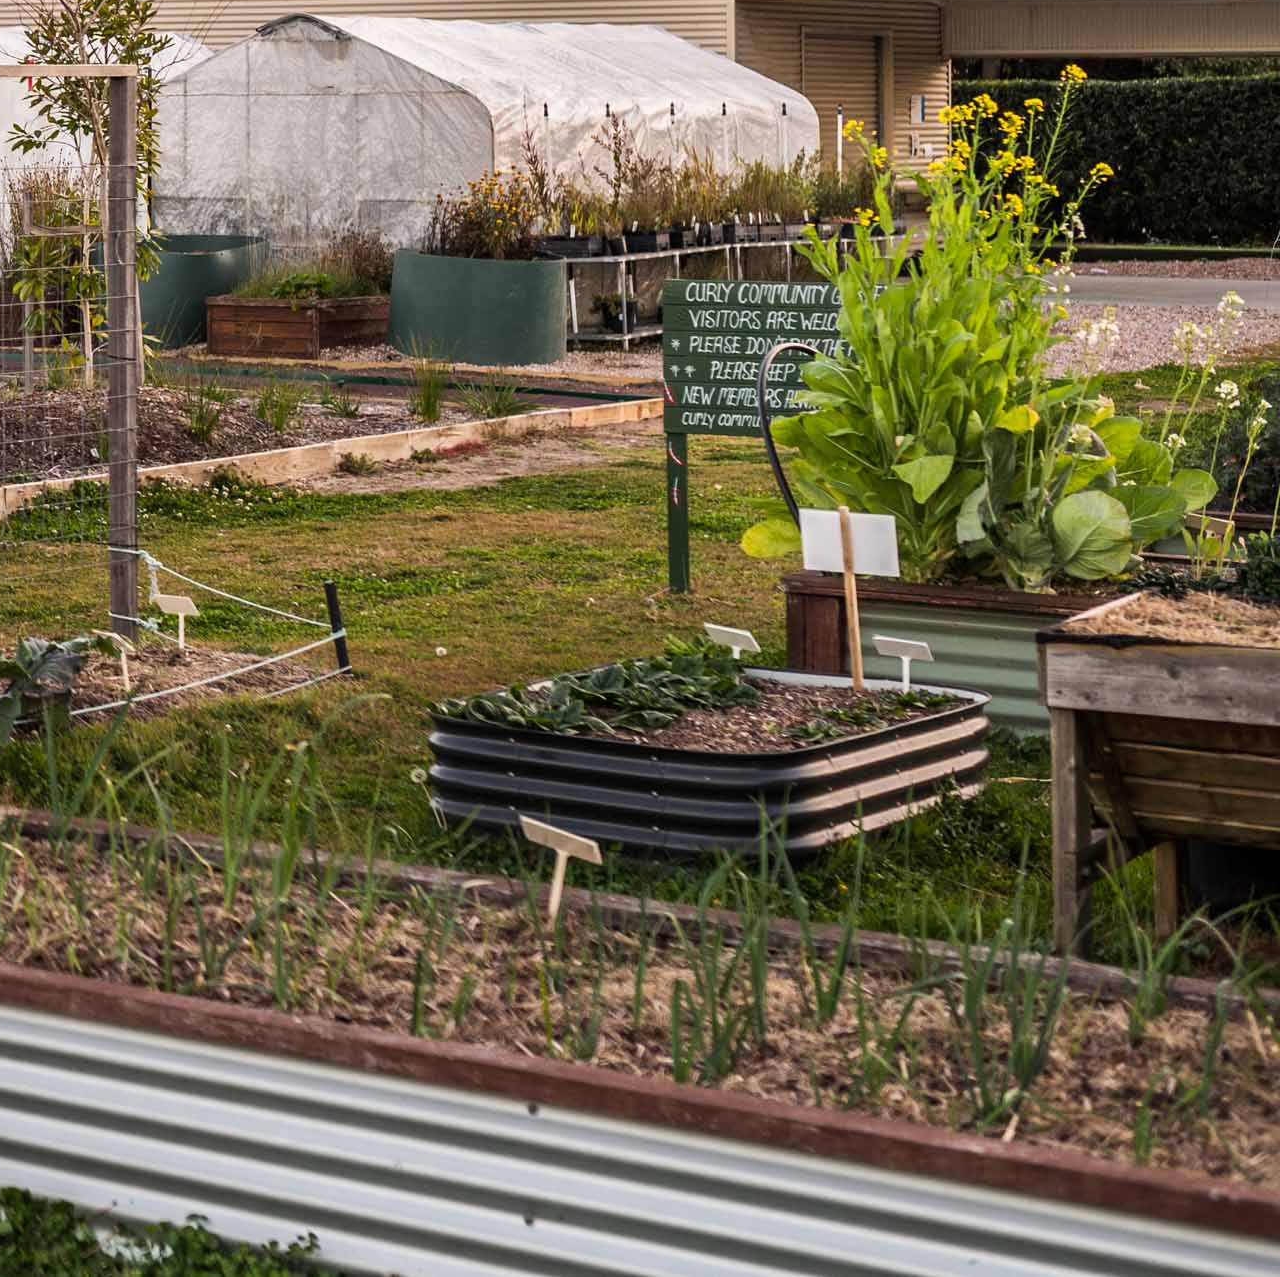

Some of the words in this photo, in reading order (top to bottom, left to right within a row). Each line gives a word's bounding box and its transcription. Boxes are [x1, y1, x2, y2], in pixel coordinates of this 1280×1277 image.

[685, 282, 735, 303] CURLY
[738, 283, 830, 304] COMMUNITY
[688, 309, 761, 330] VISITORS
[765, 311, 798, 330] ARE
[799, 312, 840, 331] WELC
[689, 335, 742, 354] PLEASE
[710, 360, 760, 381] PLEASE
[766, 363, 796, 382] EEP
[681, 385, 716, 405] NEW
[716, 387, 784, 409] MEMBRS
